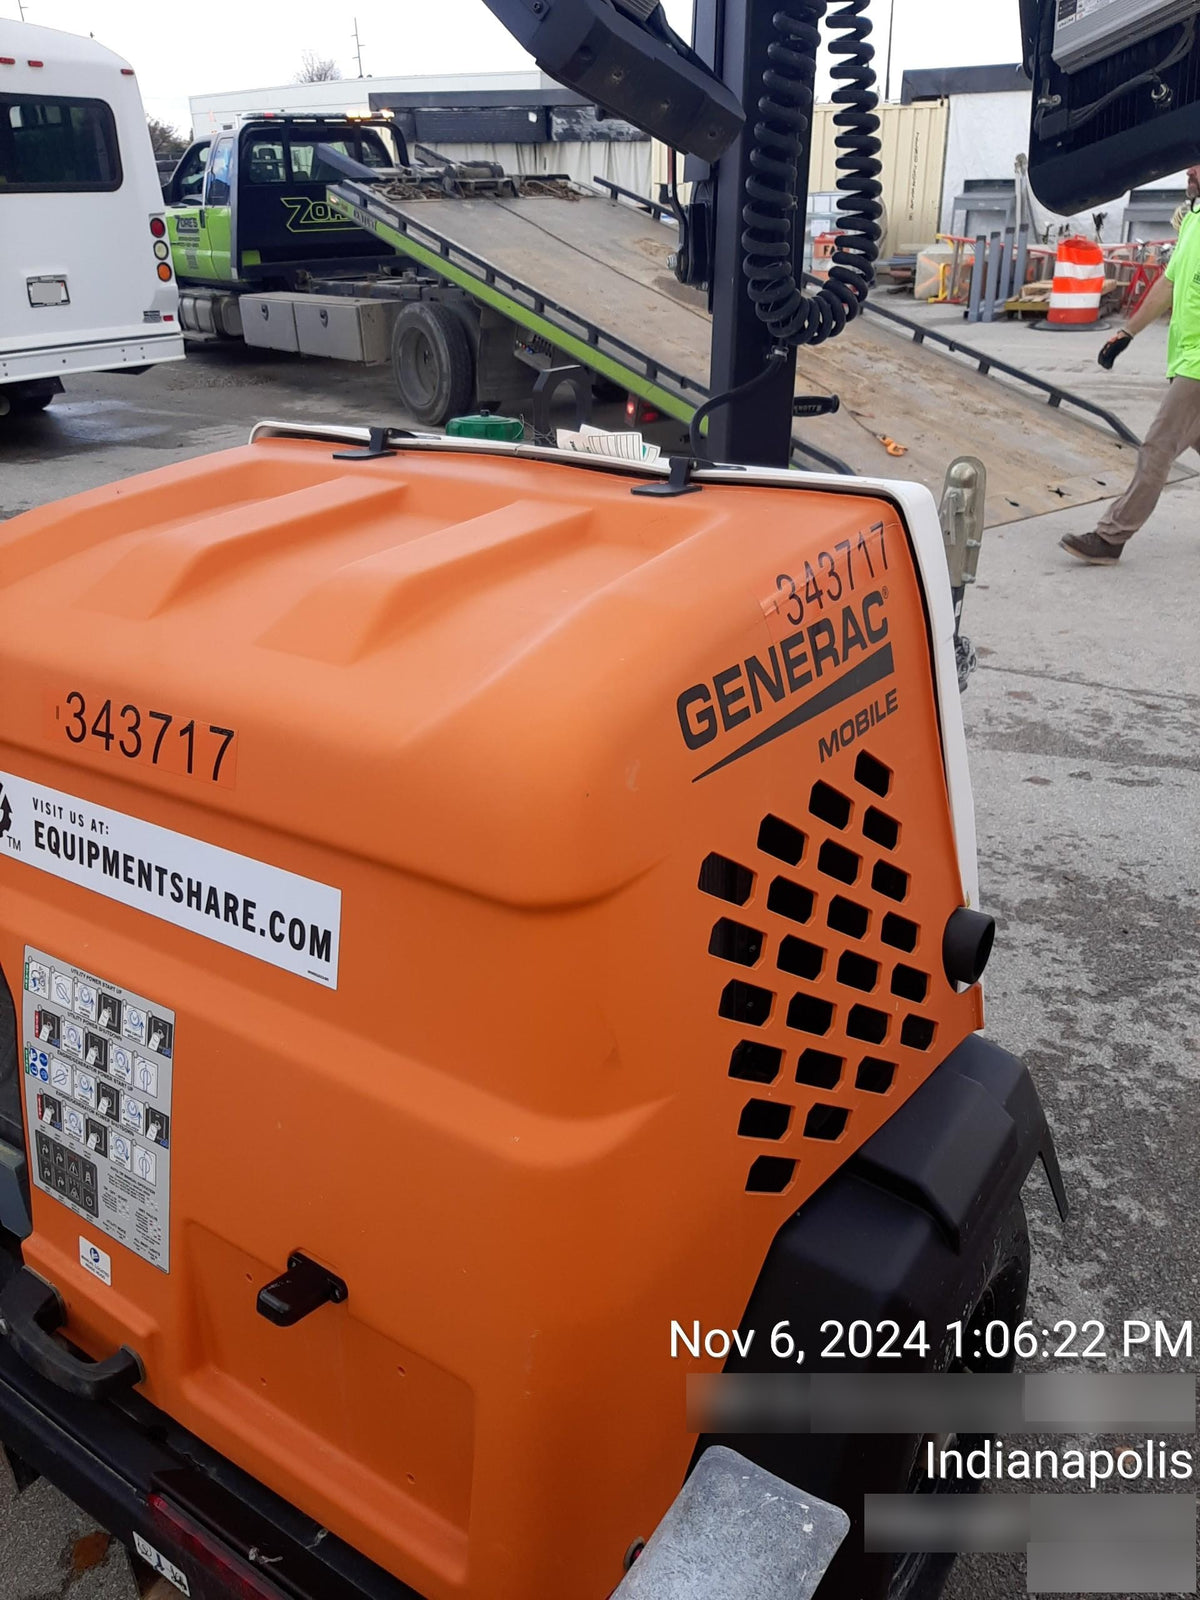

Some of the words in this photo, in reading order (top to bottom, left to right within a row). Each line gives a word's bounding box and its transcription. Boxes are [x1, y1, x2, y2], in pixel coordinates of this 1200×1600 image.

[777, 521, 888, 625] 343717
[676, 590, 889, 750] GENERAC
[65, 691, 234, 781] 343717
[818, 688, 899, 763] MOBILE
[32, 797, 63, 819] VISIT
[70, 810, 84, 827] US
[91, 818, 109, 835] AT:
[33, 819, 333, 963] EQUIPMENTSHARE.COM
[86, 975, 101, 986] POWER
[102, 982, 116, 992] START
